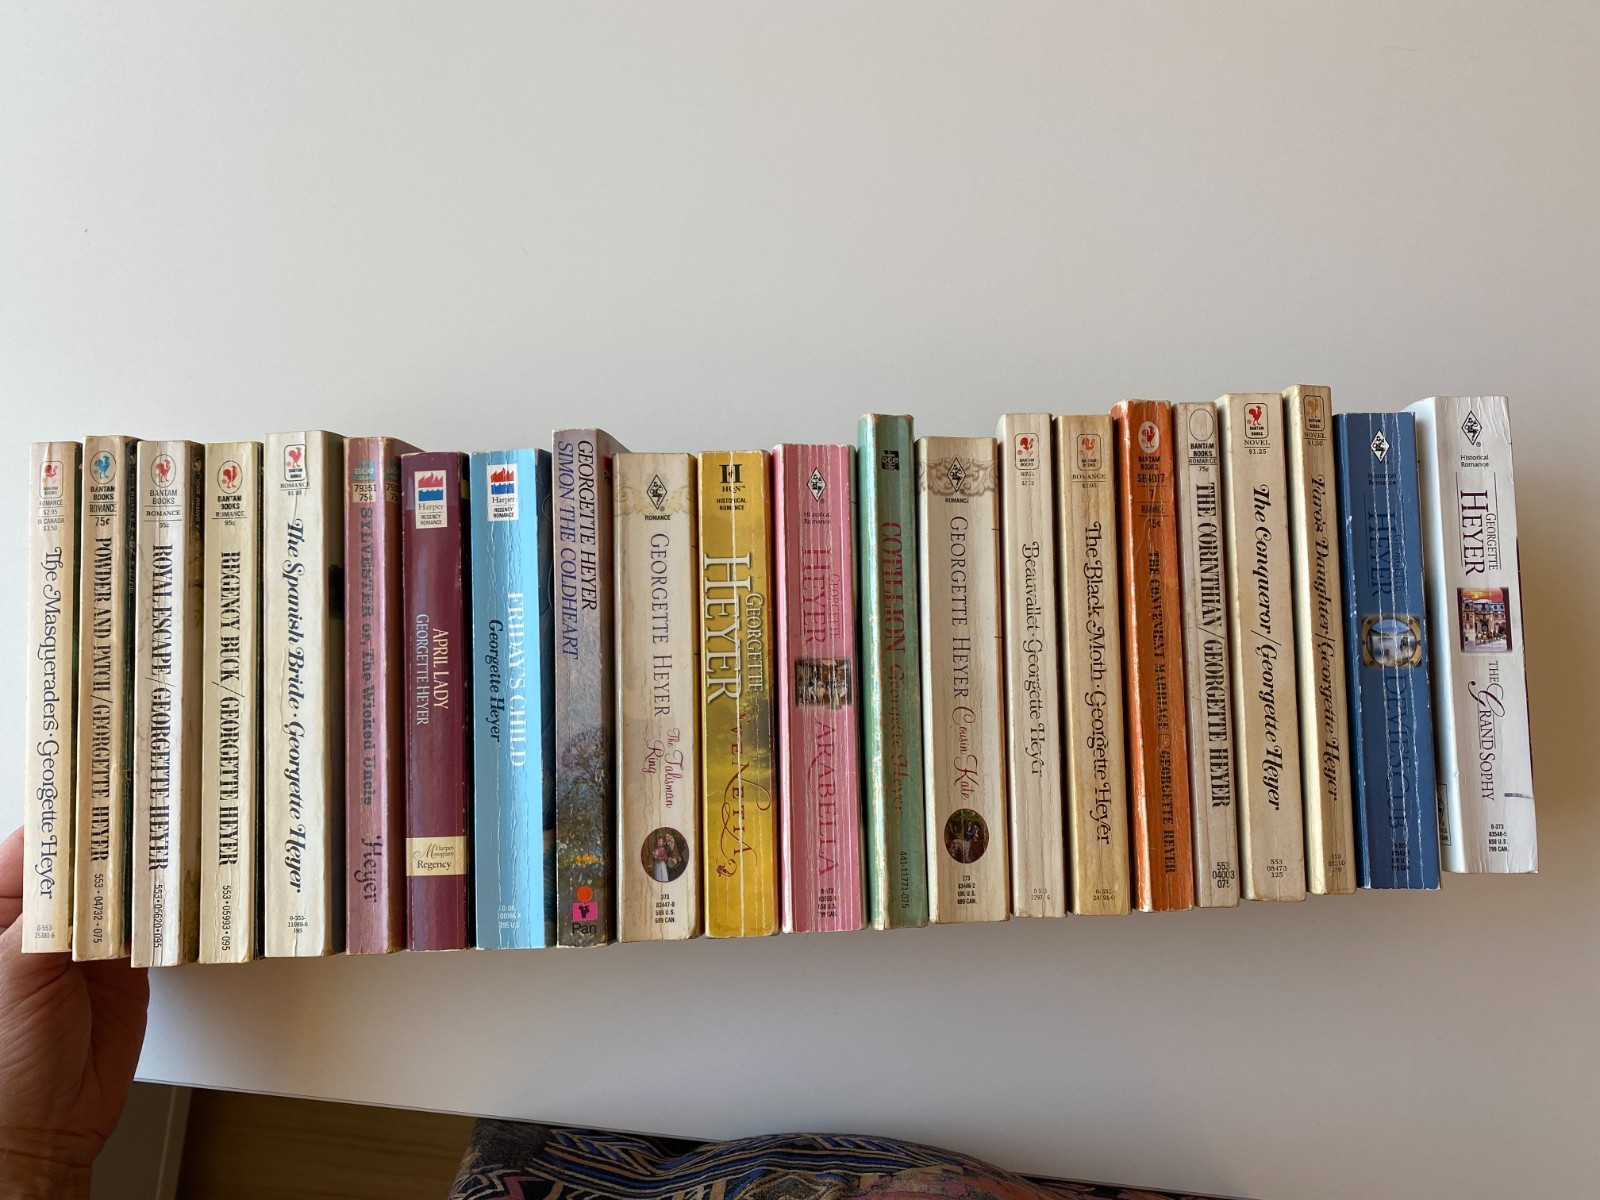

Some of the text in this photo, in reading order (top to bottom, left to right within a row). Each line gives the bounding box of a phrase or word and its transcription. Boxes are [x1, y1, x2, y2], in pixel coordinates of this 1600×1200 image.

[881, 454, 899, 464] ace
[1304, 431, 1327, 439] NOVEL
[43, 517, 65, 525] CANADA
[89, 503, 117, 513] ROMANCE
[149, 489, 178, 497] BANTAM
[152, 497, 175, 505] BOOKS
[418, 503, 444, 512] Harper
[491, 495, 515, 504] Harper
[577, 440, 597, 611] GEORGETTE HEYER
[1253, 484, 1272, 523] The
[557, 441, 579, 660] SIMON THE COLDHEART
[1368, 511, 1396, 598] HEYER
[1460, 489, 1489, 576] HEYER
[1485, 512, 1498, 571] GEORGETTE
[94, 537, 113, 604] POWDER
[152, 544, 174, 603] ROYAL
[220, 551, 241, 631] REGENCY
[801, 547, 832, 644] HEYER
[881, 521, 906, 654] COTILLION
[92, 607, 112, 640] AND
[650, 533, 672, 717] GEORGETTE HEYER
[703, 552, 752, 704] HEYER
[828, 573, 841, 639] GEORGETTE
[360, 507, 377, 806] SYLVESTER The Wicked Uncle
[415, 613, 430, 726] GEORGETTE HEYER
[432, 628, 449, 710] APRIL LADY
[745, 592, 764, 692] GEORGETTE
[950, 516, 978, 800] GEORGETTE HEYER Cousin Kate
[1022, 541, 1045, 778] Beauvallet Georgette Heyer
[1195, 482, 1217, 517] THE
[1210, 747, 1231, 809] HEYER
[282, 518, 306, 893] The Spanish Bride Georgette Heyer
[485, 619, 505, 742] Georgette Heyer
[1083, 521, 1112, 845] The Black Moth Georgette Heyer
[1148, 550, 1177, 874] THE CONVENIENT MARRIAGE GEORGETTE HEYER
[35, 547, 64, 900] The Masqueraders Georgette Heyer
[508, 696, 527, 767] CHILD
[642, 739, 665, 774] Ring
[1468, 660, 1506, 801] THE GRAND SOPHY
[664, 728, 684, 809] The Talisman
[807, 720, 839, 876] ARABELLA
[1261, 745, 1285, 812] Heyer
[1322, 737, 1341, 802] Heyer
[90, 805, 110, 863] HEYER
[149, 805, 170, 871] HEYER
[218, 806, 238, 867] HEYER
[416, 859, 452, 871] Regency
[1216, 861, 1231, 870] 553
[354, 835, 383, 903] Heyer
[1212, 870, 1235, 879] 04003
[571, 922, 597, 935] Pan
